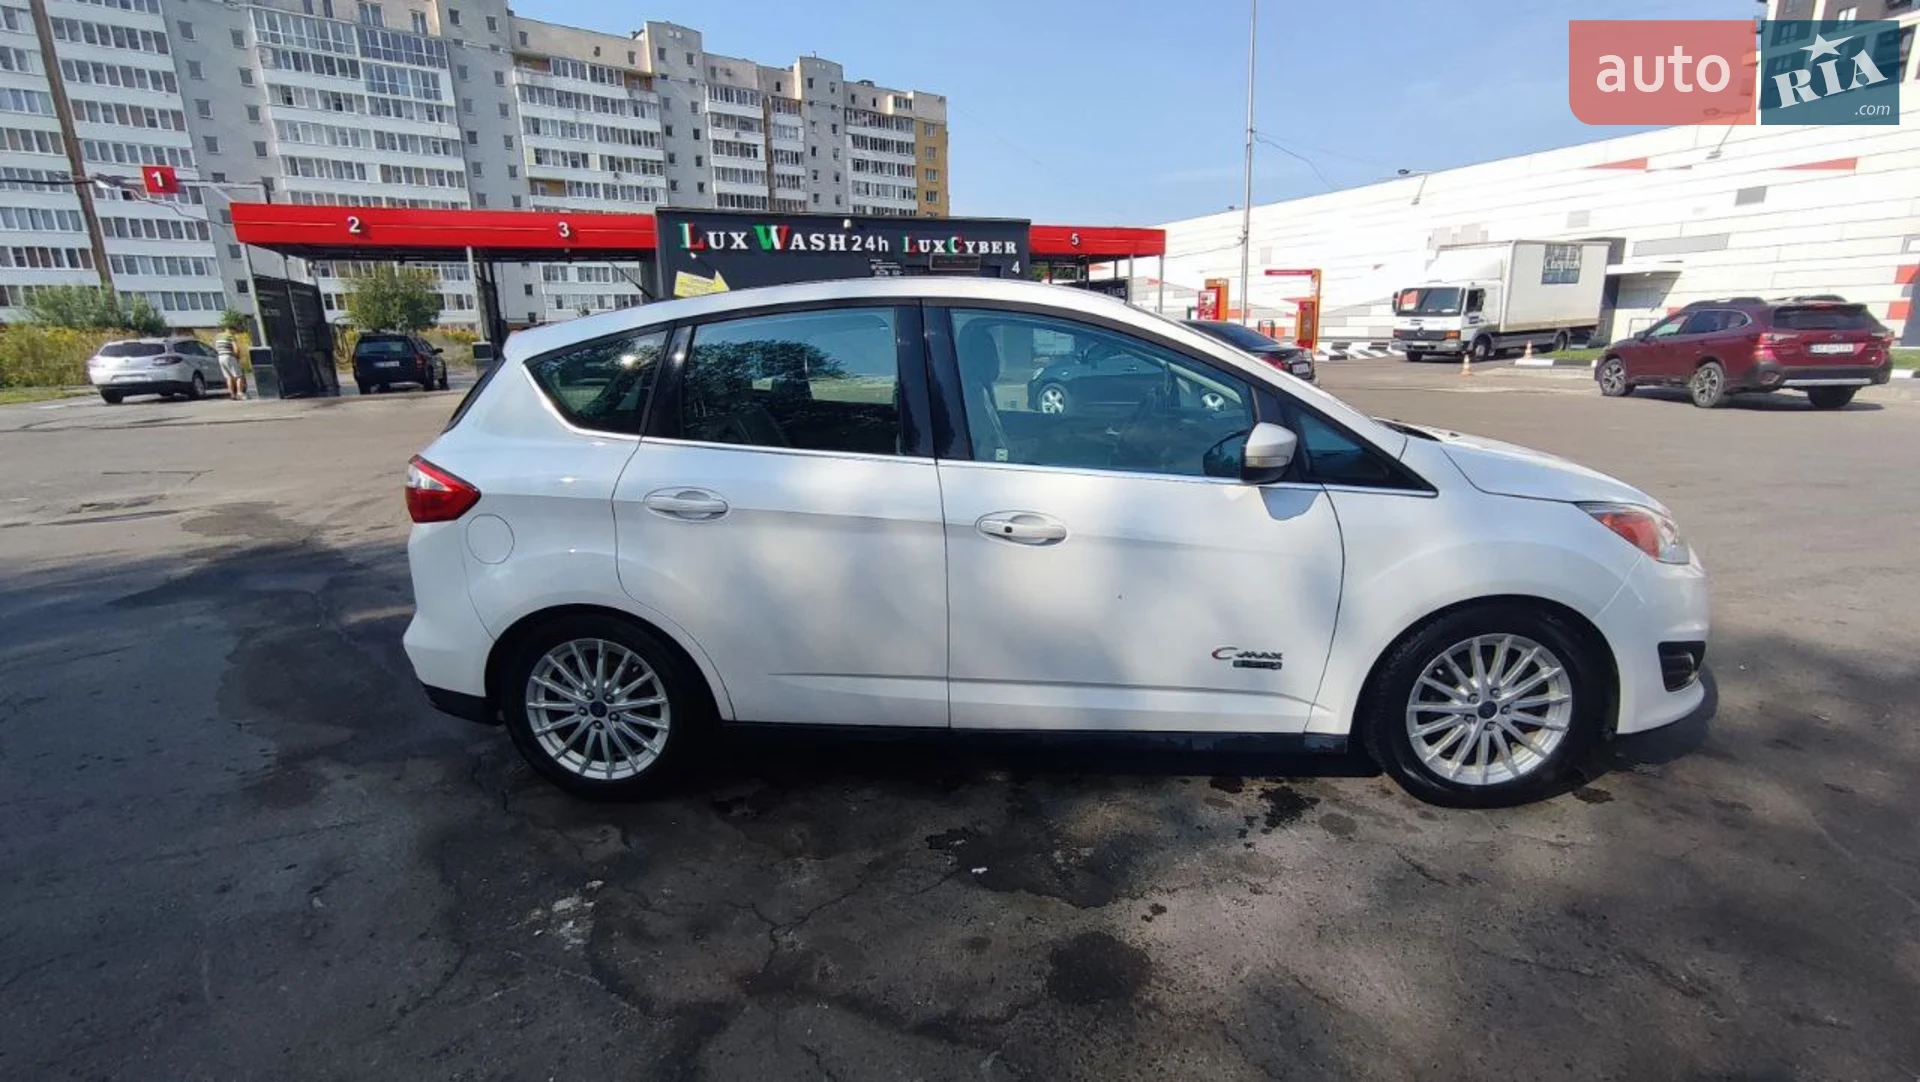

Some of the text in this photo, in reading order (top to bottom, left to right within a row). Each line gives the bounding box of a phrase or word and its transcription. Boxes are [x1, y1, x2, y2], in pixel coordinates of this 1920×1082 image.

[152, 171, 164, 187] 1
[347, 216, 361, 233] 2
[558, 221, 570, 237] 3
[1071, 233, 1079, 246] 5
[1011, 260, 1020, 274] 4
